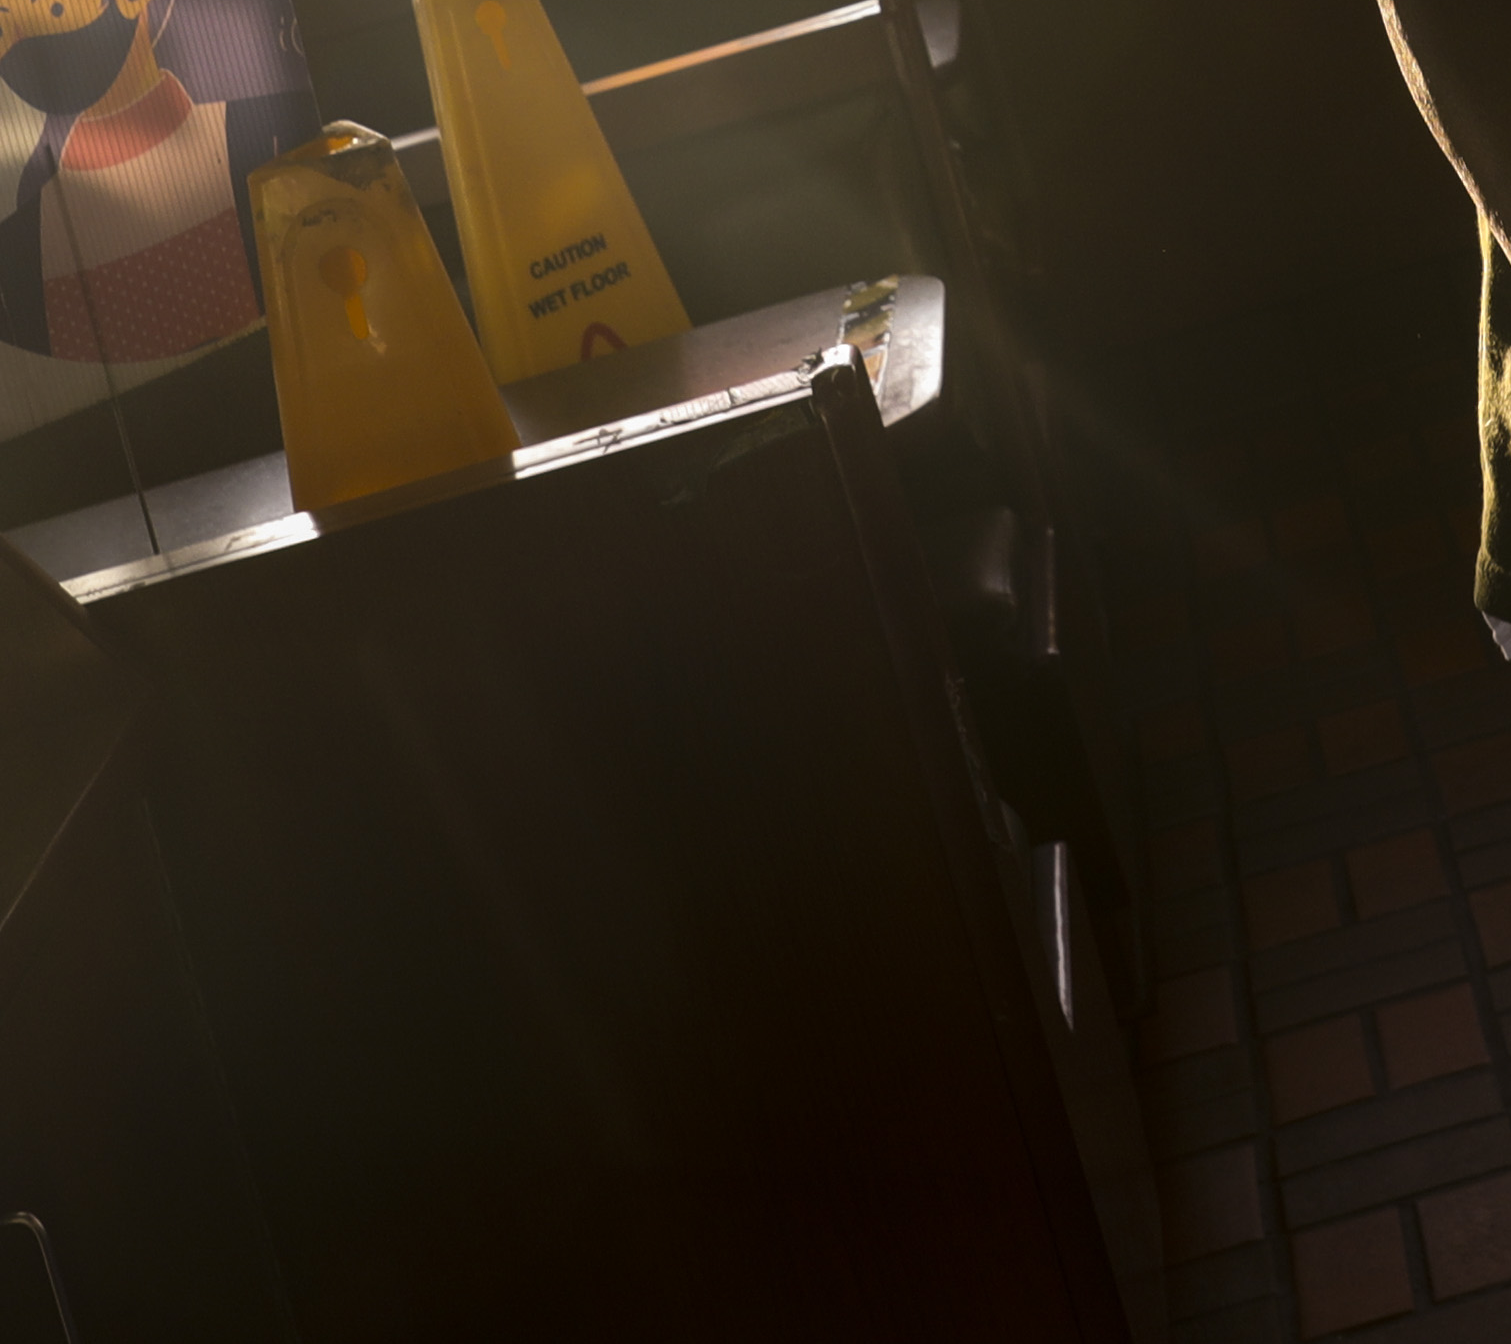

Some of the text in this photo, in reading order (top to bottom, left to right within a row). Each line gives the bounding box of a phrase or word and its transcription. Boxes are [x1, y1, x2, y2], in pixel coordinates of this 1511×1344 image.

[529, 234, 607, 280] CAUTION
[528, 261, 632, 319] WET FLOOR
